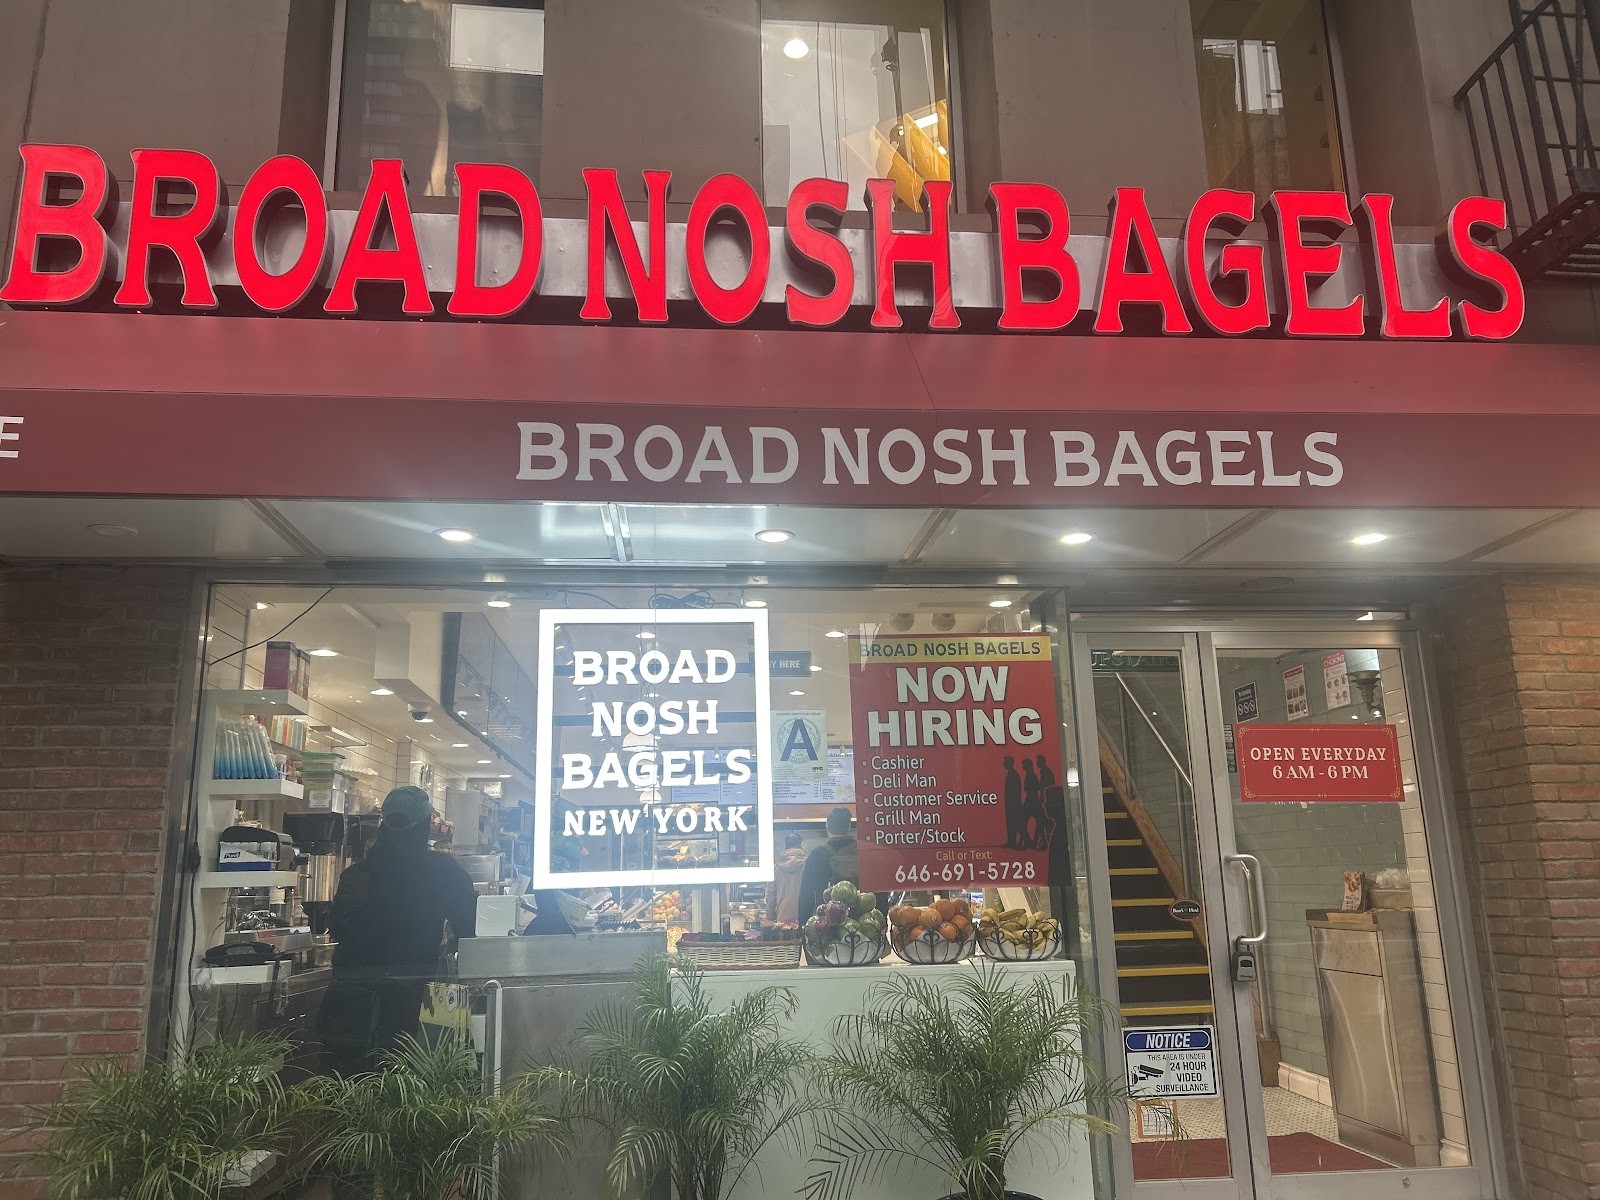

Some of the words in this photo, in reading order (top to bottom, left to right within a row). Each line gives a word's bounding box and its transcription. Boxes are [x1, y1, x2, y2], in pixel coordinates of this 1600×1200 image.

[1, 143, 542, 317] BROAD
[580, 167, 962, 329] NOSH
[989, 181, 1526, 339] BAGELS
[516, 421, 800, 484] BROAD
[821, 427, 1030, 487] NOSH
[1051, 430, 1345, 488] BAGELS
[859, 643, 918, 657] BROAD
[924, 642, 970, 656] NOSH
[974, 641, 1041, 656] BAGELS
[572, 649, 737, 686] BROAD
[780, 660, 801, 669] HERE
[895, 665, 1009, 703] NOW
[590, 699, 719, 737] NOSH
[867, 707, 1043, 747] HIRING
[780, 719, 818, 761] A
[1250, 747, 1295, 761] OPEN
[1300, 747, 1387, 761] EVERYDAY
[561, 748, 752, 790] BAGELS
[871, 755, 925, 770] Cashier
[1272, 765, 1283, 779] 6
[1286, 765, 1315, 779] AM
[1328, 765, 1338, 779] 6
[1341, 765, 1369, 779] PM
[872, 773, 901, 788] Deli
[906, 773, 937, 788] Man
[873, 792, 942, 807] Customer
[946, 790, 998, 805] Service
[563, 808, 641, 837] NEW
[653, 806, 748, 833] YORK
[874, 810, 906, 826] Grill
[909, 810, 941, 825] Man
[875, 827, 966, 845] Porter/Stock
[936, 850, 955, 861] Call
[957, 852, 967, 861] or
[970, 850, 993, 860] Text:
[894, 861, 1036, 883] 646-691-5728
[1145, 1033, 1191, 1049] NOTICE
[1162, 1053, 1178, 1061] AREA
[1179, 1053, 1185, 1061] IS
[1170, 1062, 1180, 1071] 24
[1183, 1061, 1207, 1071] HOUR
[1176, 1072, 1202, 1082] VIDEO
[1156, 1083, 1209, 1093] SURVEILLANCE
